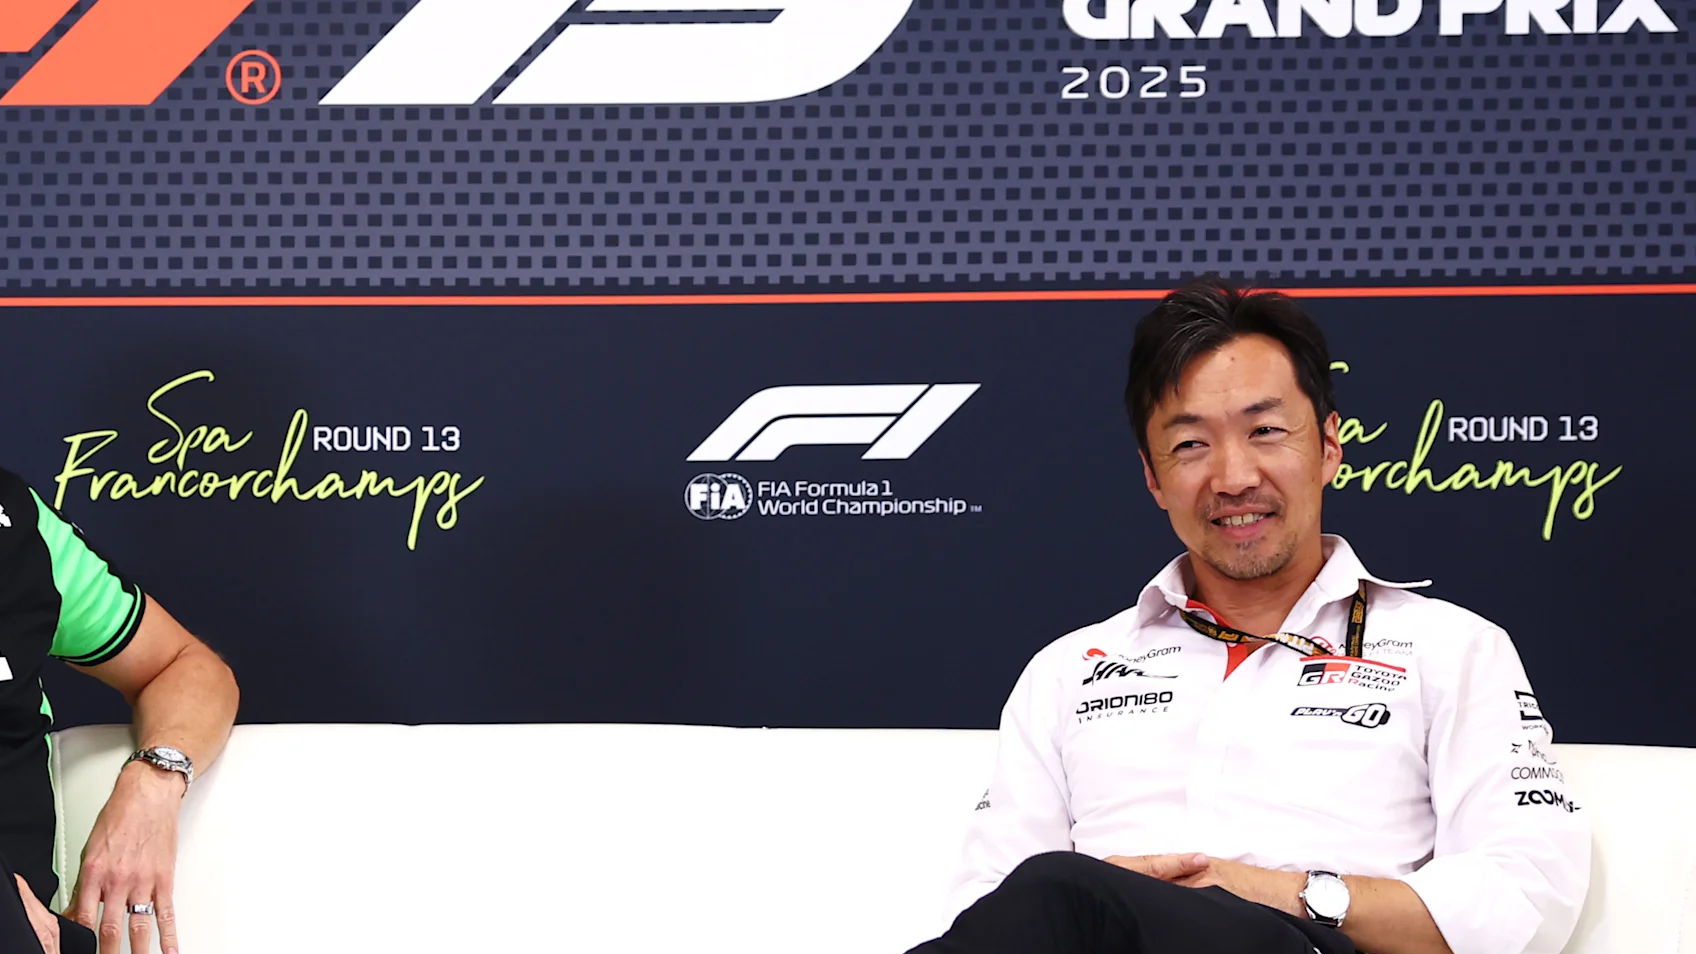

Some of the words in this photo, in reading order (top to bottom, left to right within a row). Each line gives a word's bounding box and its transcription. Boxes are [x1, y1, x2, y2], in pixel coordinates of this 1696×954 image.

[1061, 65, 1207, 99] 2025
[147, 370, 253, 471] Spa
[685, 382, 982, 461] F1
[1448, 415, 1549, 442] ROUND
[1558, 415, 1599, 441] 13
[313, 425, 411, 451] ROUND
[421, 425, 462, 451] 13
[54, 408, 485, 551] Francorchamps
[1331, 399, 1623, 541] orchamps
[758, 480, 791, 497] FIA
[795, 480, 879, 497] Formula
[882, 480, 893, 496] 1
[758, 499, 819, 516] World
[822, 496, 967, 517] Championship
[1351, 671, 1401, 687] GAZOO
[1354, 664, 1407, 680] TOYOTA
[1348, 678, 1396, 693] Racing
[1078, 706, 1169, 724] INSURANCE
[1342, 703, 1387, 729] GO
